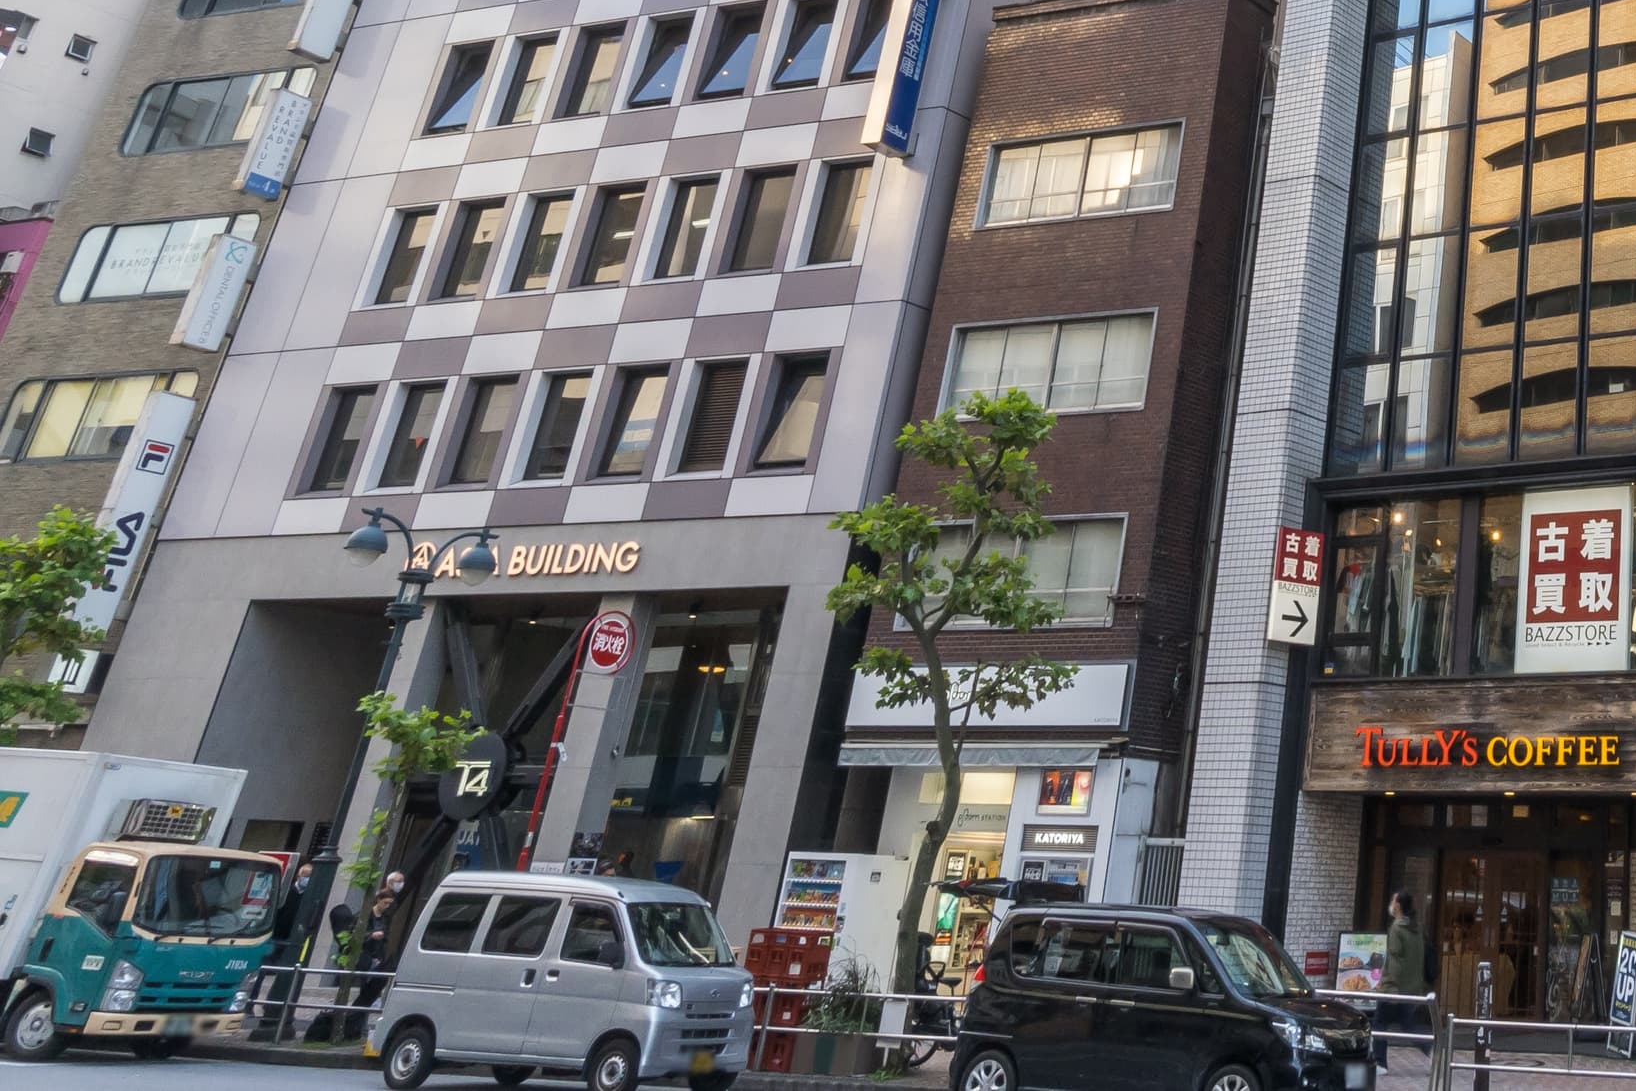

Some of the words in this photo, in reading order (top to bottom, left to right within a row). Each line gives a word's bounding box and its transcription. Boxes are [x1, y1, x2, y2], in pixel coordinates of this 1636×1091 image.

[1285, 532, 1321, 558] 古着
[1535, 517, 1615, 564] 古着
[507, 540, 641, 576] BUILDING
[1281, 556, 1319, 582] 買取
[1532, 570, 1615, 616] 買取
[592, 632, 625, 655] 消火栓
[1525, 624, 1617, 643] BAZZSTORE
[1355, 727, 1479, 767] TULLY'S
[1486, 735, 1620, 767] COFFEE
[456, 759, 492, 797] T4
[1034, 832, 1084, 844] KATORIYA
[1616, 972, 1635, 1003] UP
